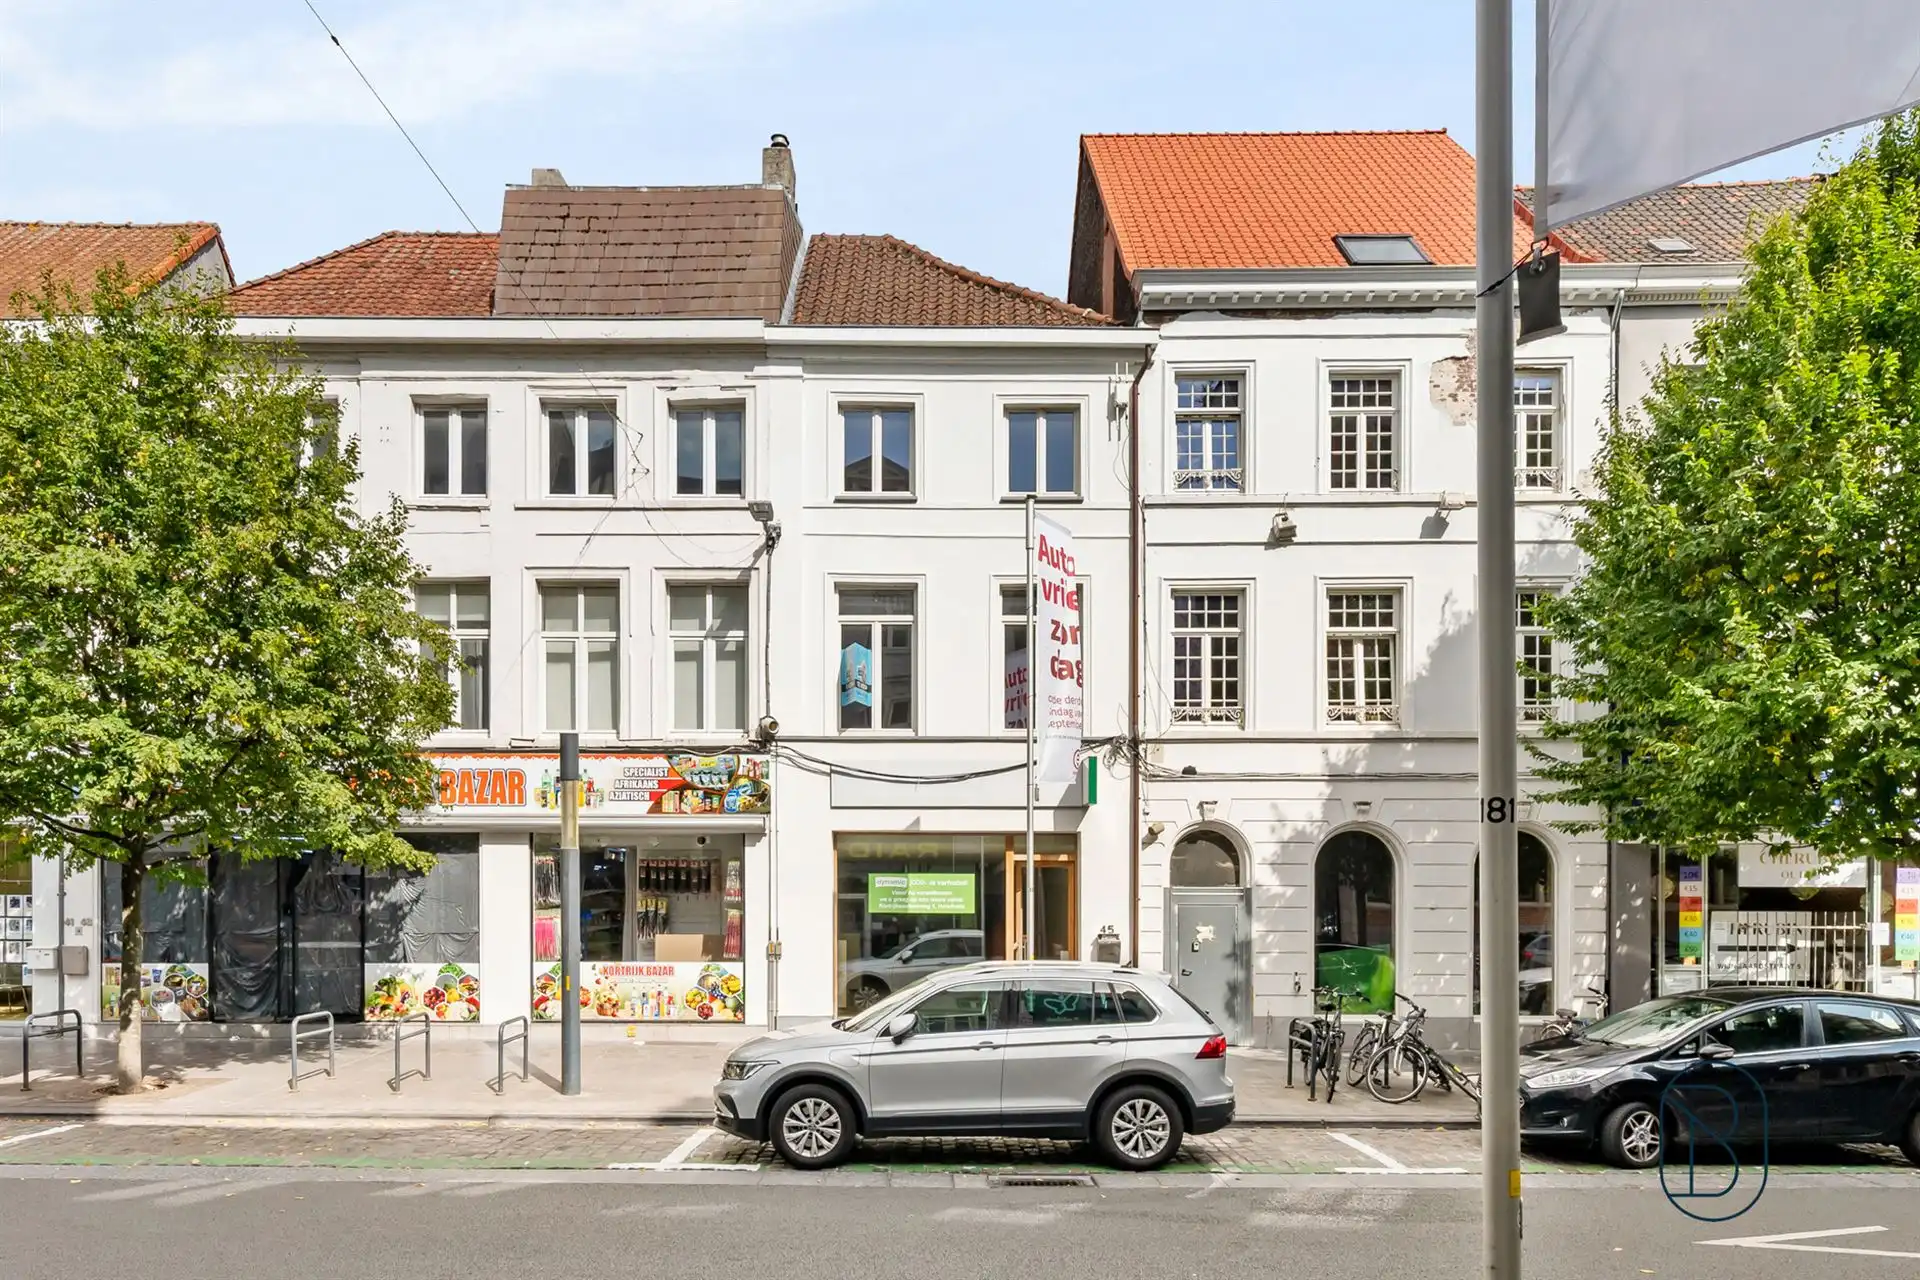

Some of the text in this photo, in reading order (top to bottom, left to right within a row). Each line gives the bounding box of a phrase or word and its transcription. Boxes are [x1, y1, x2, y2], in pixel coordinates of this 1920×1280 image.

[1041, 578, 1081, 612] vrie
[624, 767, 669, 778] SPECIALIST
[440, 769, 527, 806] BAZAR
[614, 779, 660, 790] AFRIKAANS
[609, 791, 650, 801] AZIATISCH
[1100, 924, 1115, 934] 45
[602, 965, 675, 977] KORTRIJK BAZAR
